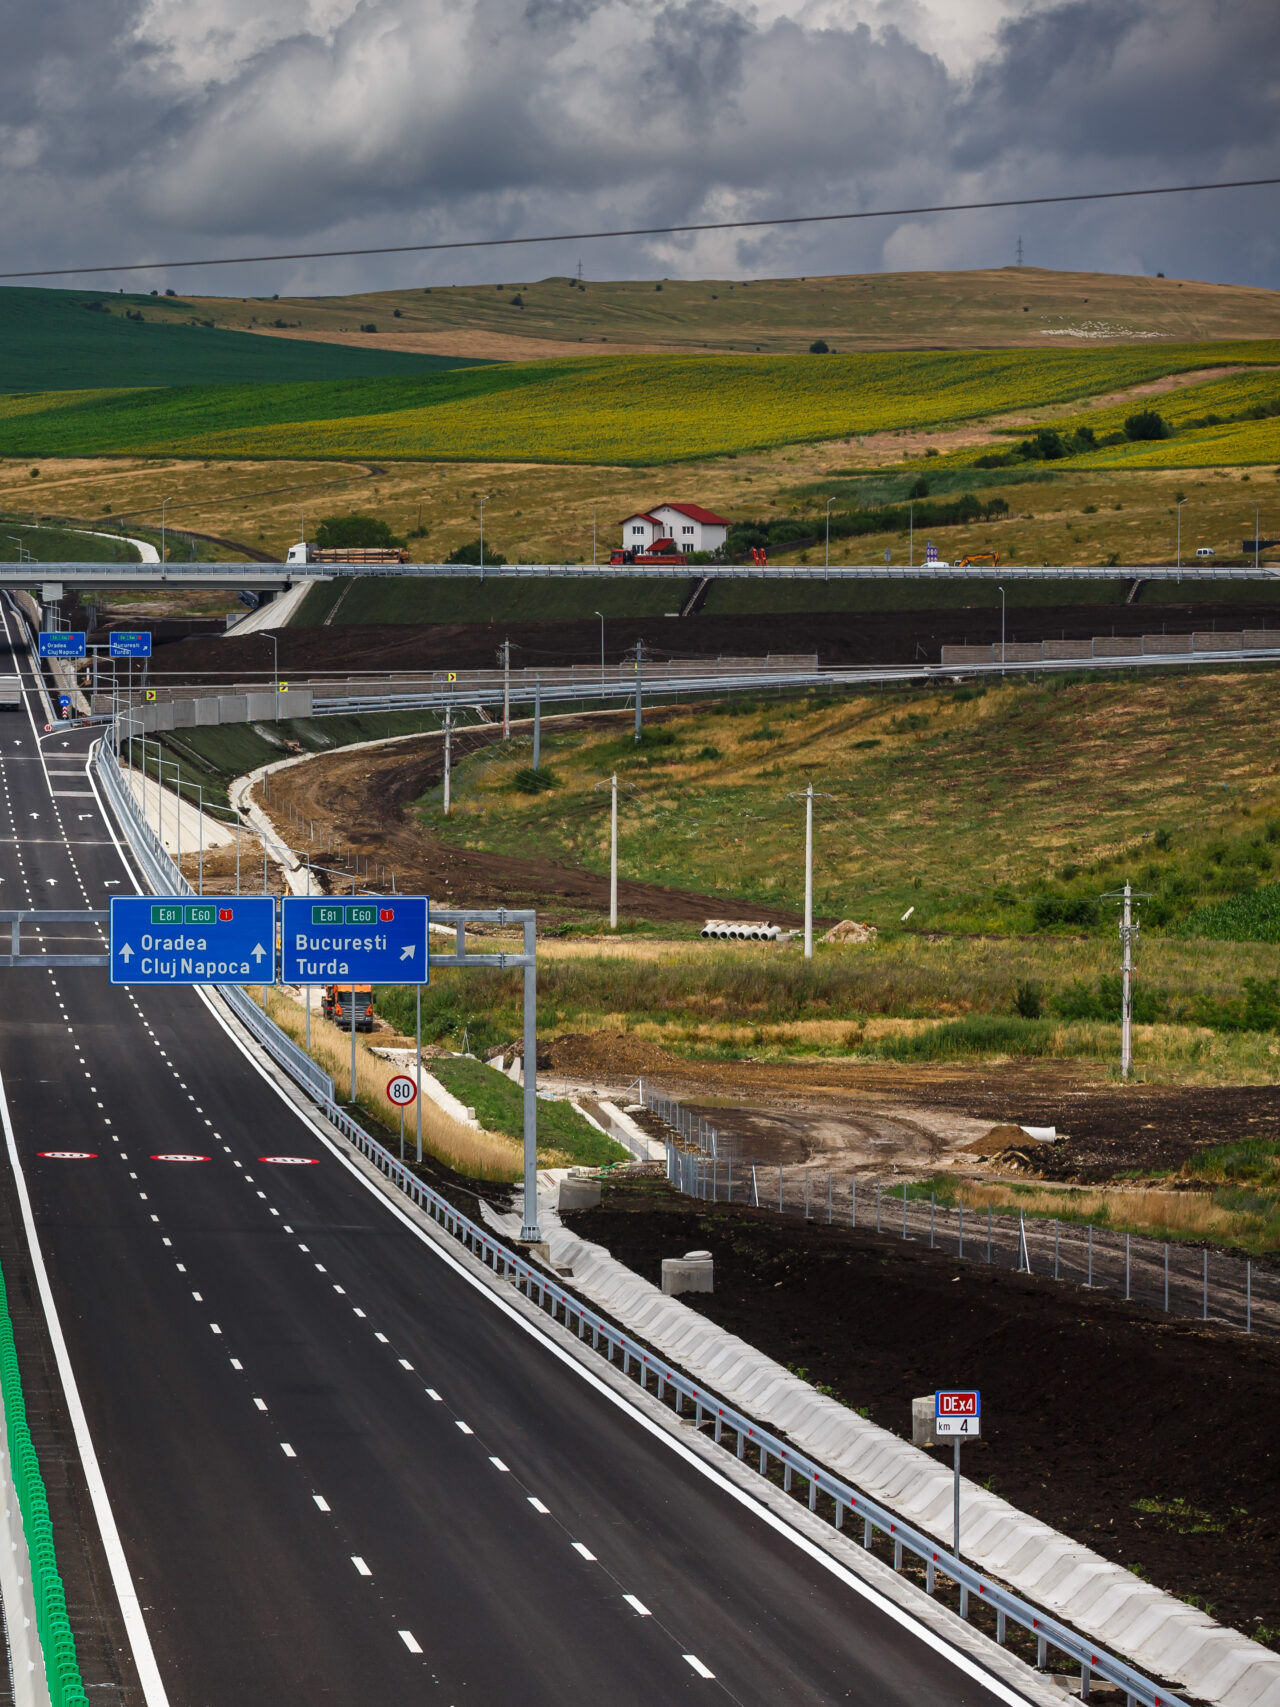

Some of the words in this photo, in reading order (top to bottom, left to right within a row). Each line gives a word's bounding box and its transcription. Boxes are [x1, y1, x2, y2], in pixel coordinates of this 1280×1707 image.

[159, 908, 176, 921] E81
[191, 908, 211, 921] E60
[320, 908, 337, 921] E81
[352, 908, 371, 921] E60
[141, 934, 207, 951] Oradea
[296, 934, 387, 953] București
[141, 957, 177, 978] Cluj
[180, 957, 250, 978] Napoca
[296, 958, 349, 975] Turda
[393, 1083, 410, 1098] 80
[943, 1396, 973, 1411] DEx4
[939, 1422, 951, 1431] km
[960, 1418, 968, 1433] 4
